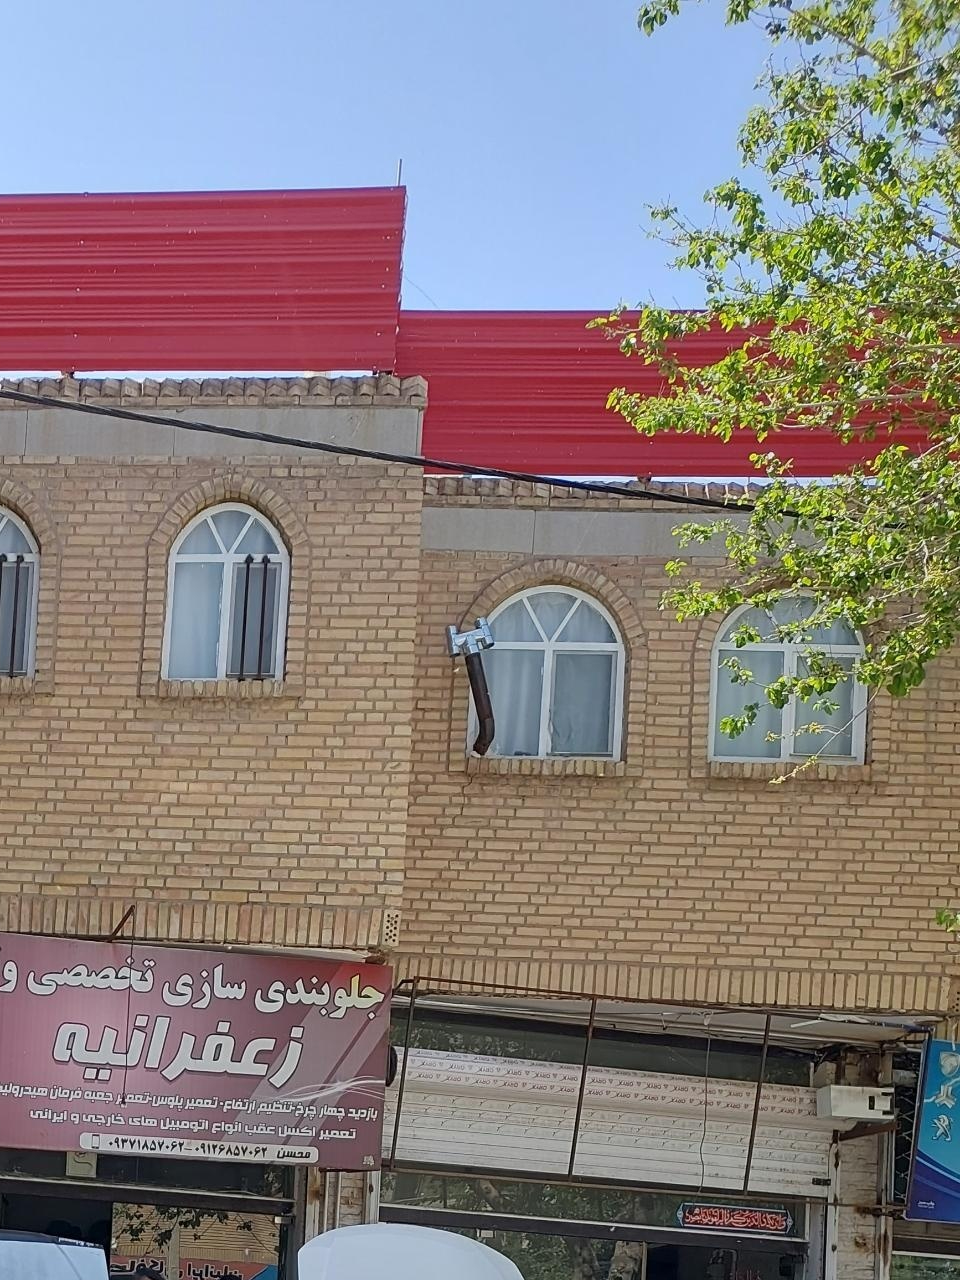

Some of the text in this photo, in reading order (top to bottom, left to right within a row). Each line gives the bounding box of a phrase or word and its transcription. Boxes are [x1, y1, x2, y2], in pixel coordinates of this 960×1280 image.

[27, 956, 156, 995] تخصصی
[162, 963, 247, 1009] سازی
[254, 973, 385, 1020] جلوبندی
[53, 1014, 304, 1089] زعفرانیه
[49, 1085, 83, 1100] فرمان
[84, 1091, 114, 1104] جعبه
[183, 1096, 218, 1110] تعمیر
[318, 1105, 346, 1118] چهار
[348, 1106, 378, 1121] بازدید
[29, 1108, 356, 1140] تعمیر اکسل عقب انواع اتومبیل های خارجی و ایرانی
[276, 1149, 311, 1160] محسن
